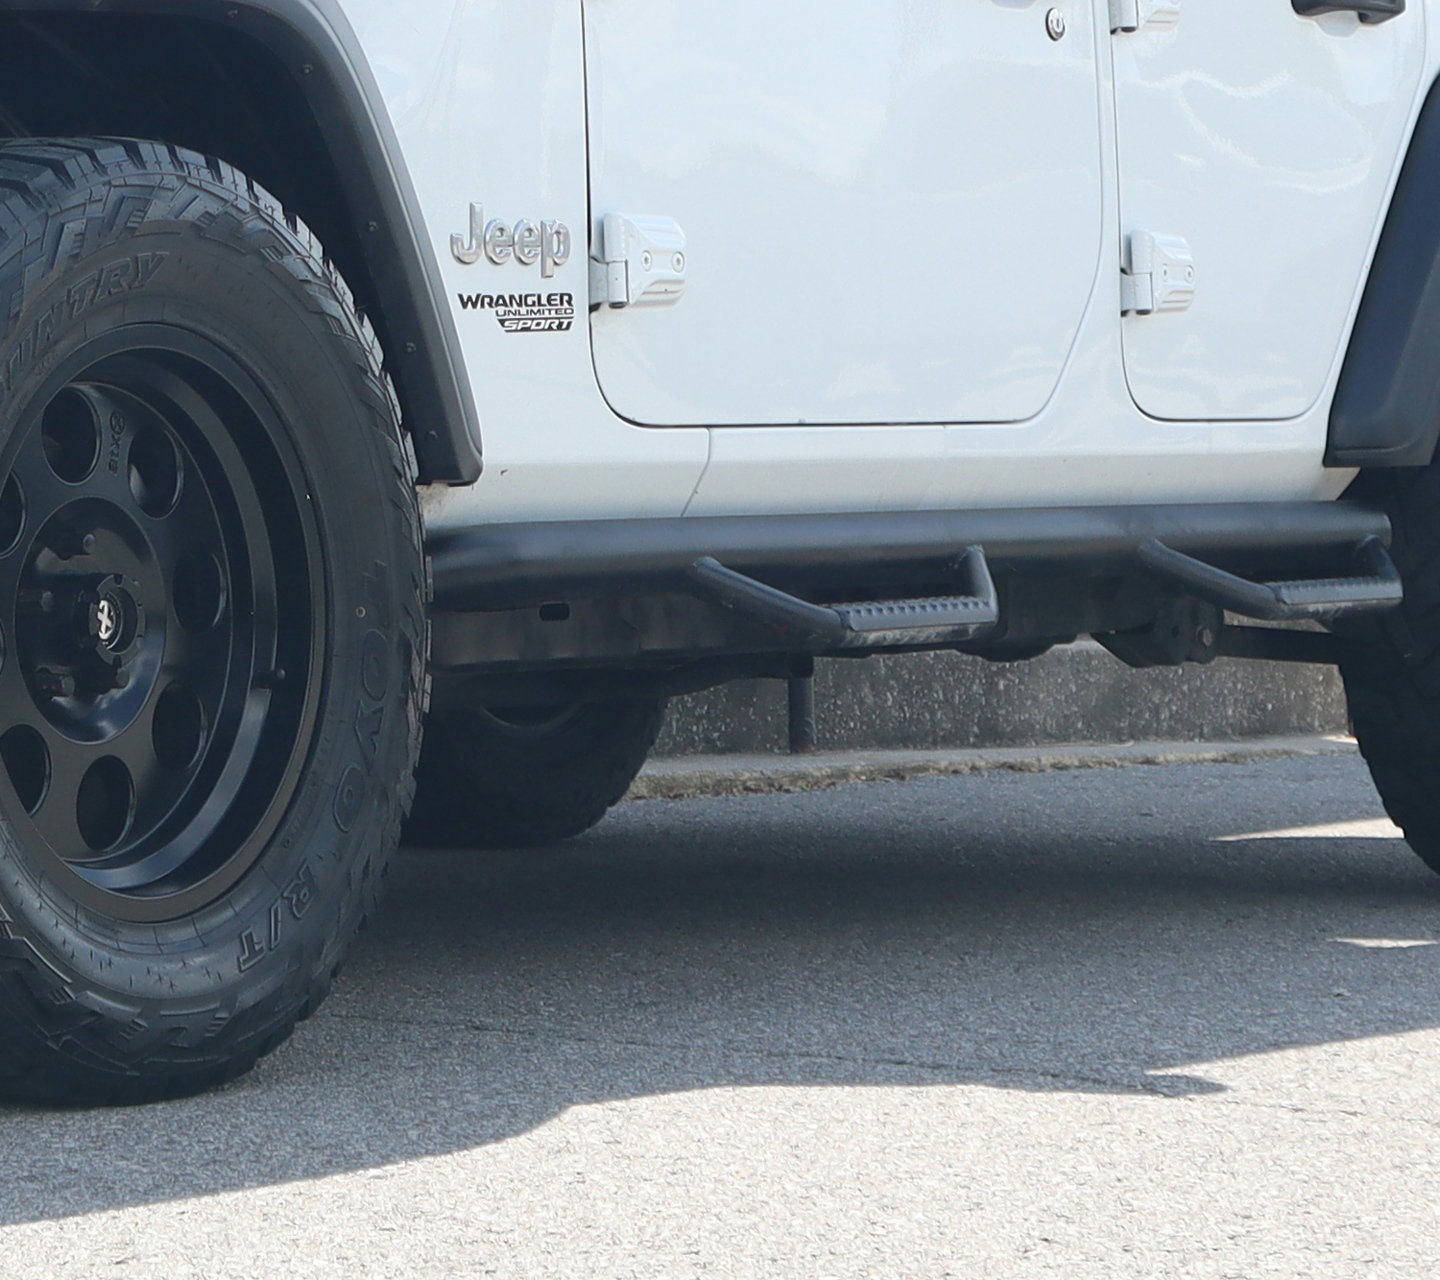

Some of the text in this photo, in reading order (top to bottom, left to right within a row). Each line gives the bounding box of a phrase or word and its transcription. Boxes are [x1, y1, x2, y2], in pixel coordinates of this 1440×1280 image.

[450, 201, 572, 278] Jeep
[458, 293, 573, 309] WRANGLER
[495, 308, 574, 317] UNLIMITED
[503, 319, 574, 331] SPORT
[333, 558, 390, 835] TOYO
[237, 861, 319, 973] R/T
